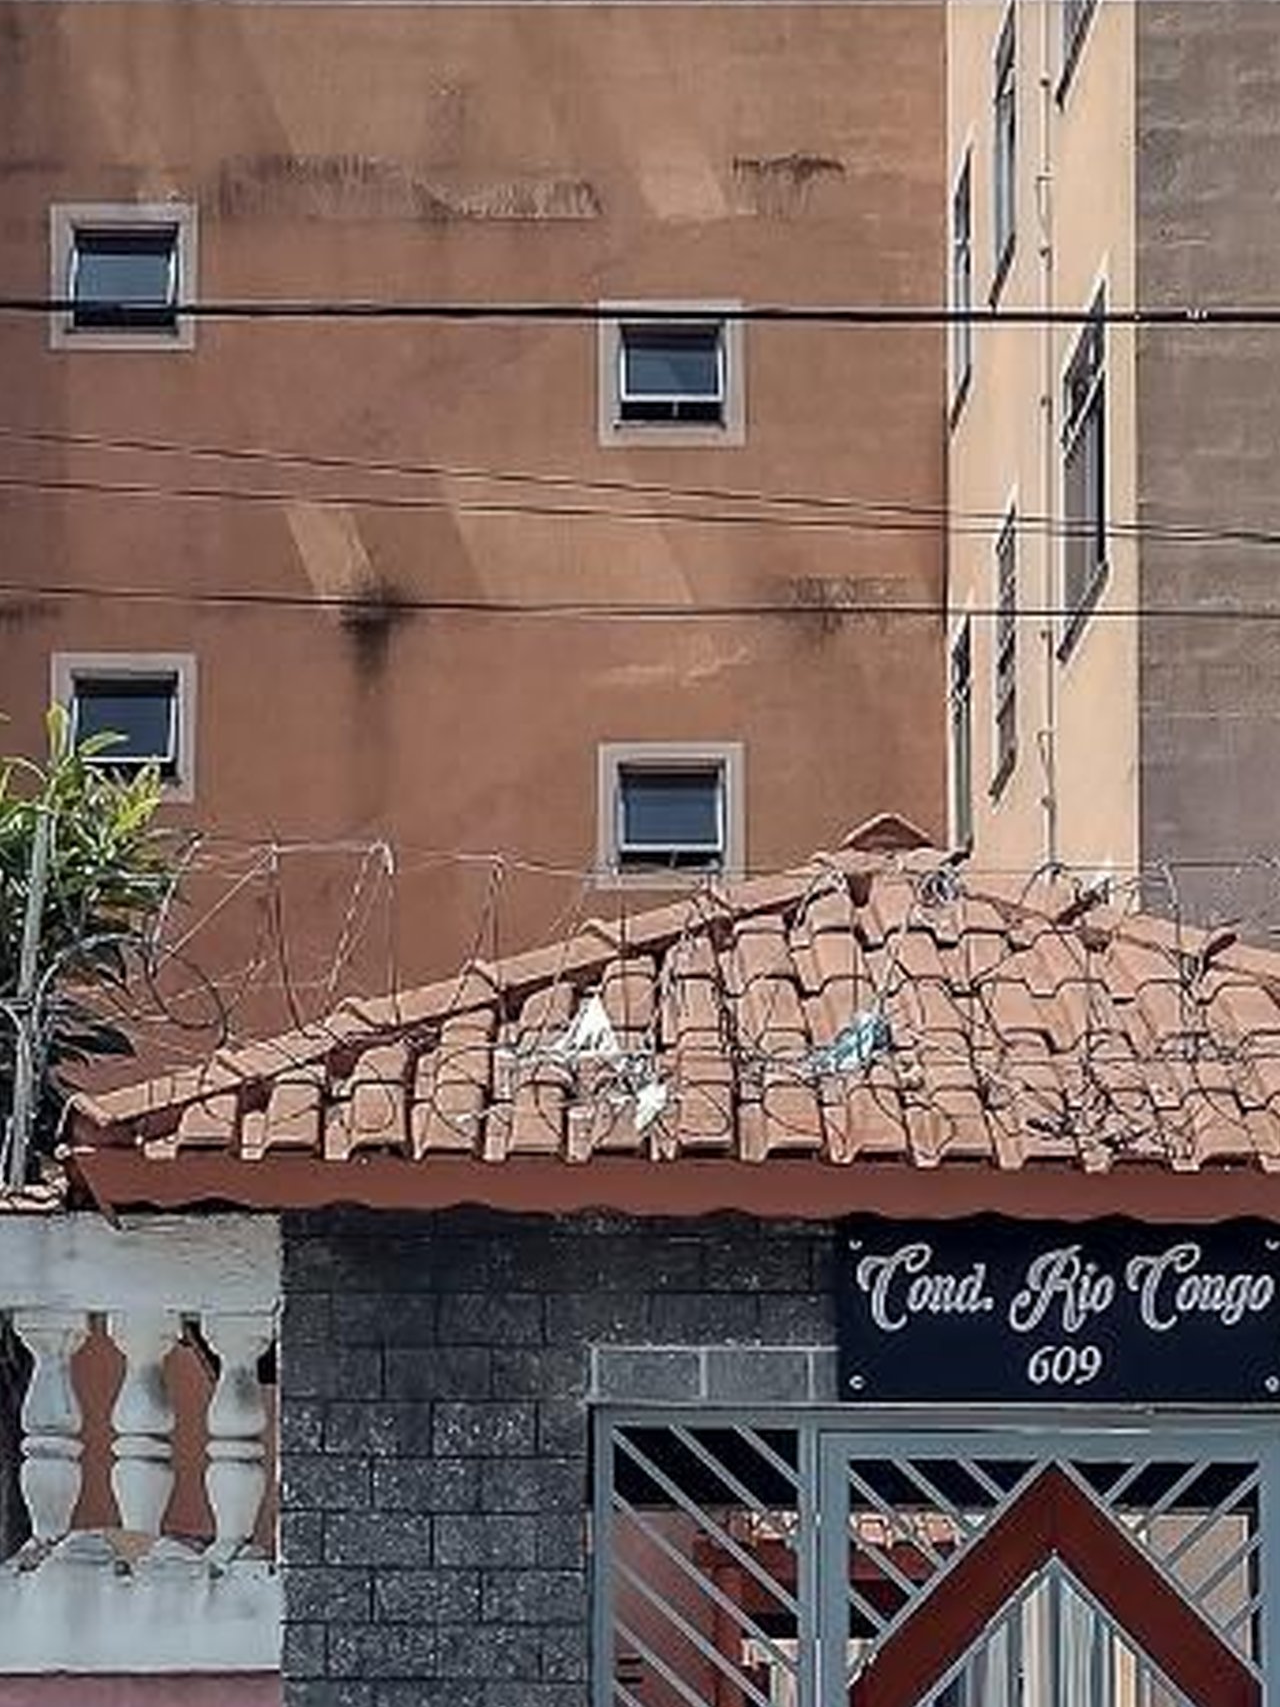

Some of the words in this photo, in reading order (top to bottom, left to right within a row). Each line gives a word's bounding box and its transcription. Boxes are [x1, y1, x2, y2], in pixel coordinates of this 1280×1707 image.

[856, 1243, 994, 1330] Cond.
[1009, 1245, 1115, 1332] Rio
[1125, 1243, 1275, 1330] Congo
[1027, 1345, 1102, 1385] 609
